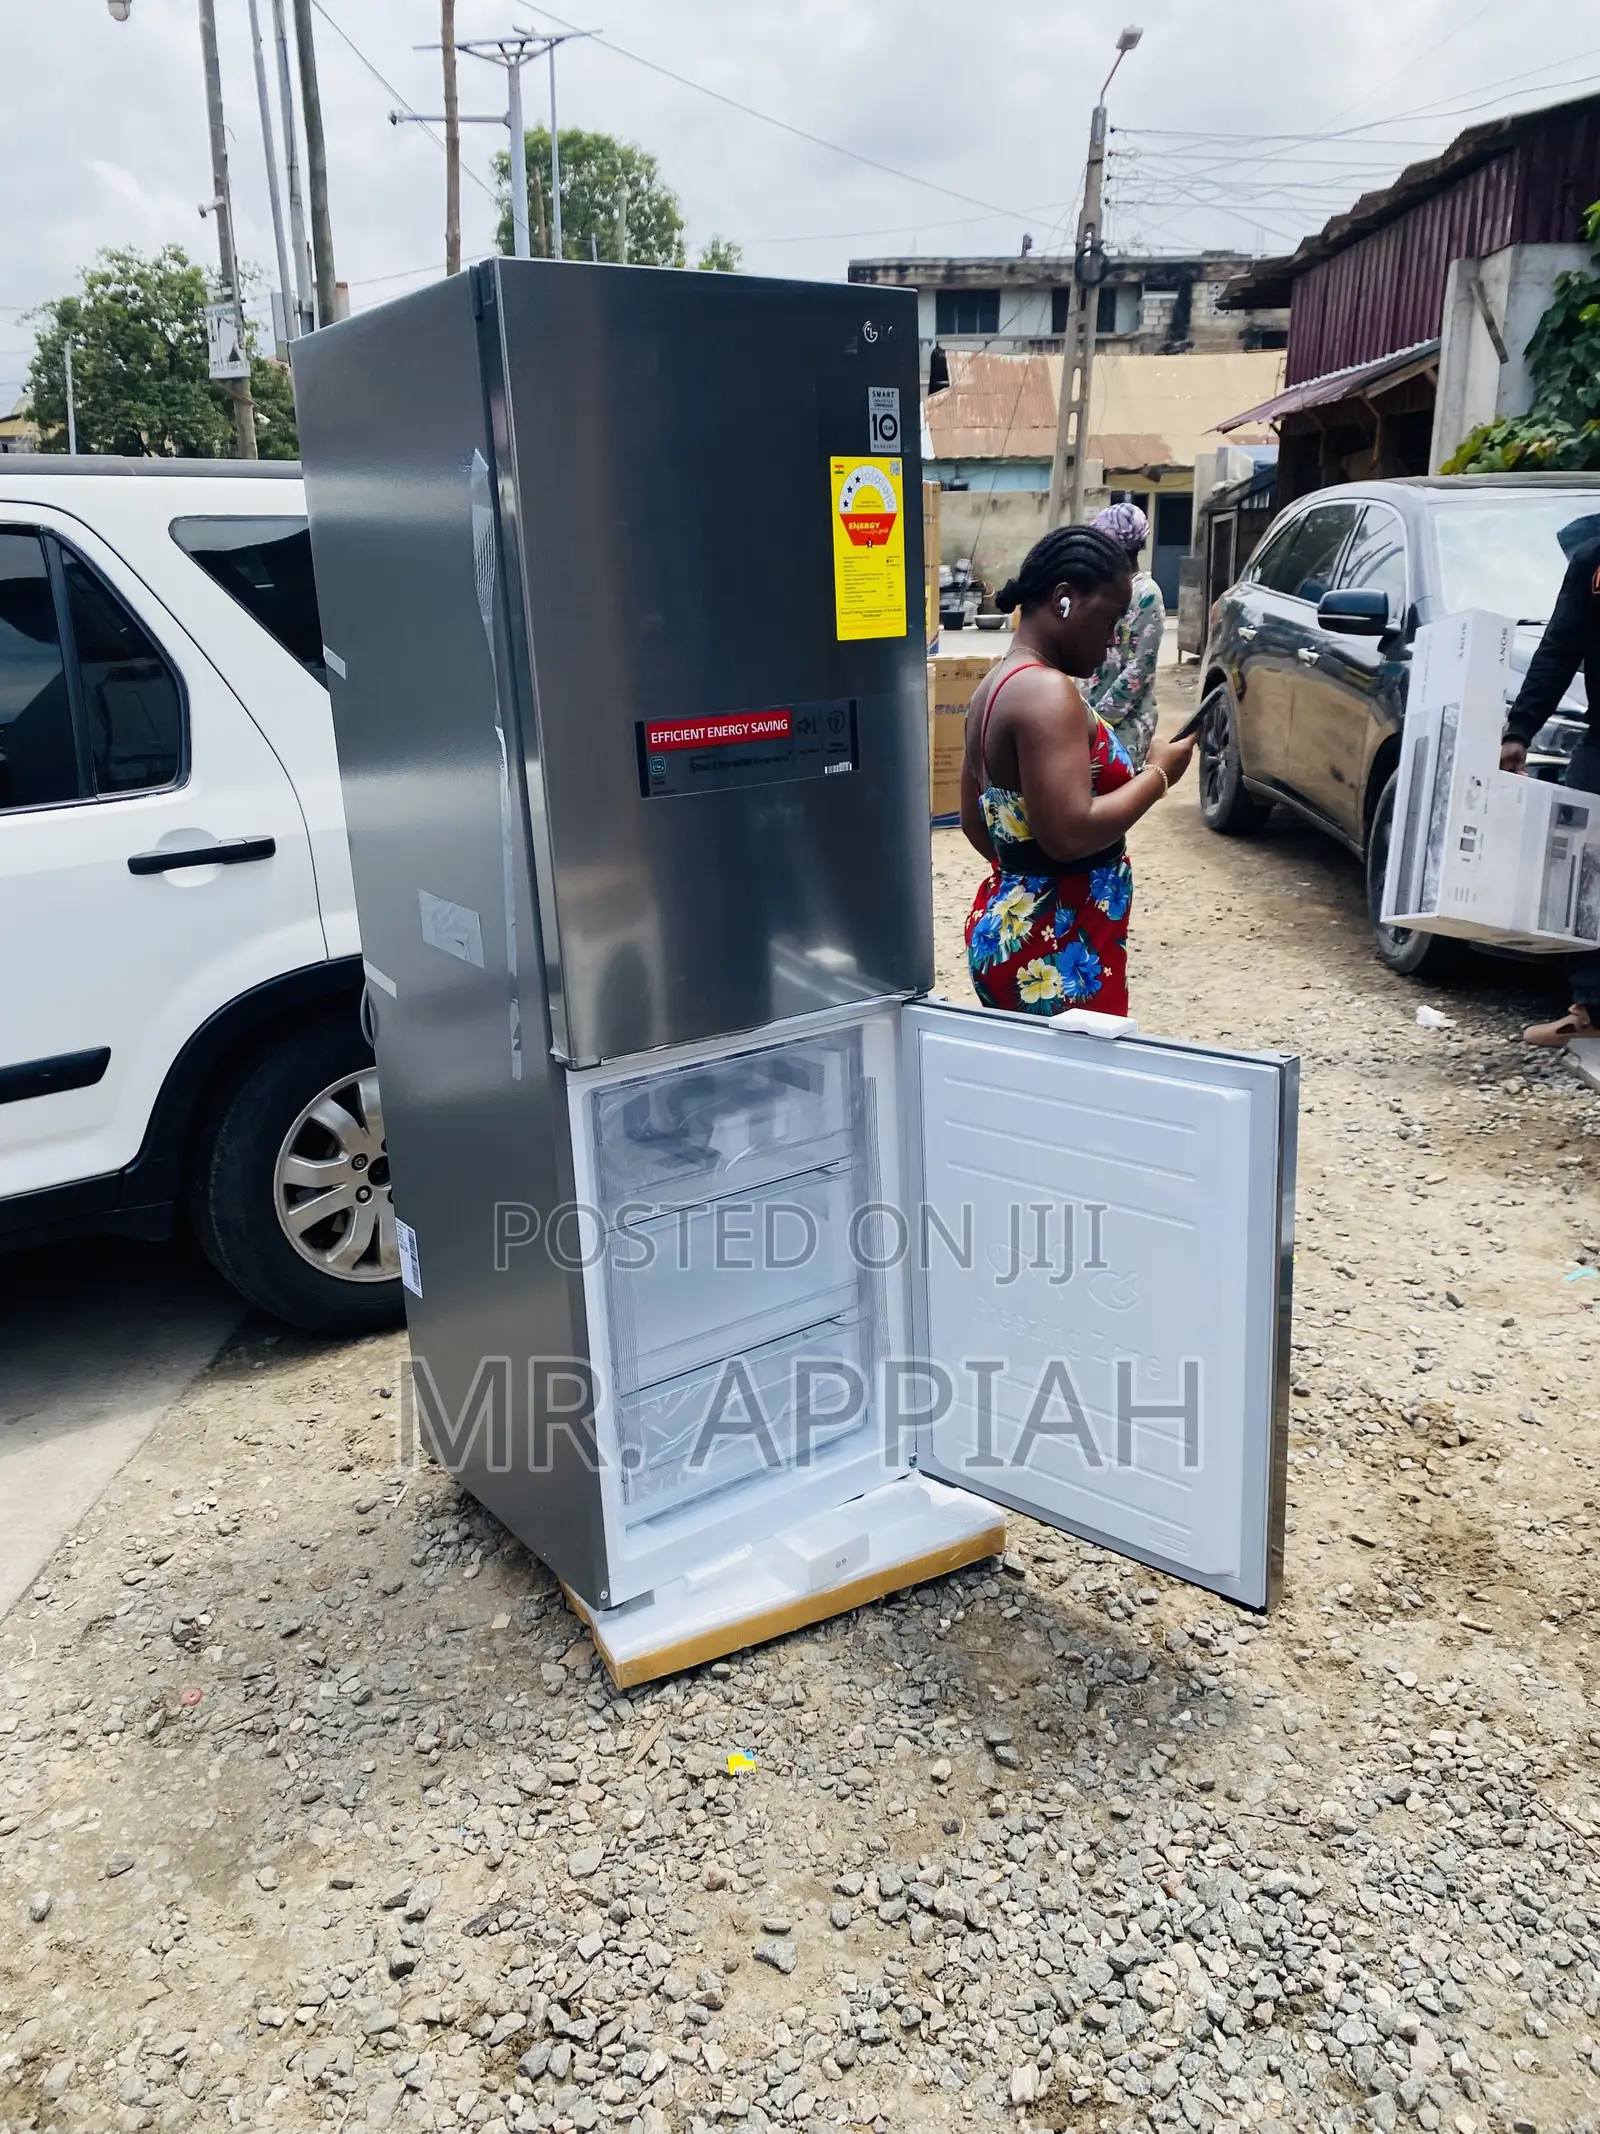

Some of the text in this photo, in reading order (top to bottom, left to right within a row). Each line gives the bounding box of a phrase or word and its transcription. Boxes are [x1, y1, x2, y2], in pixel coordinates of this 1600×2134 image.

[871, 390, 895, 398] SMART
[872, 413, 898, 441] 10
[848, 522, 880, 531] ENERGY
[1499, 628, 1508, 666] SONY
[651, 719, 788, 744] EFFICIENT ENERGY SAVING
